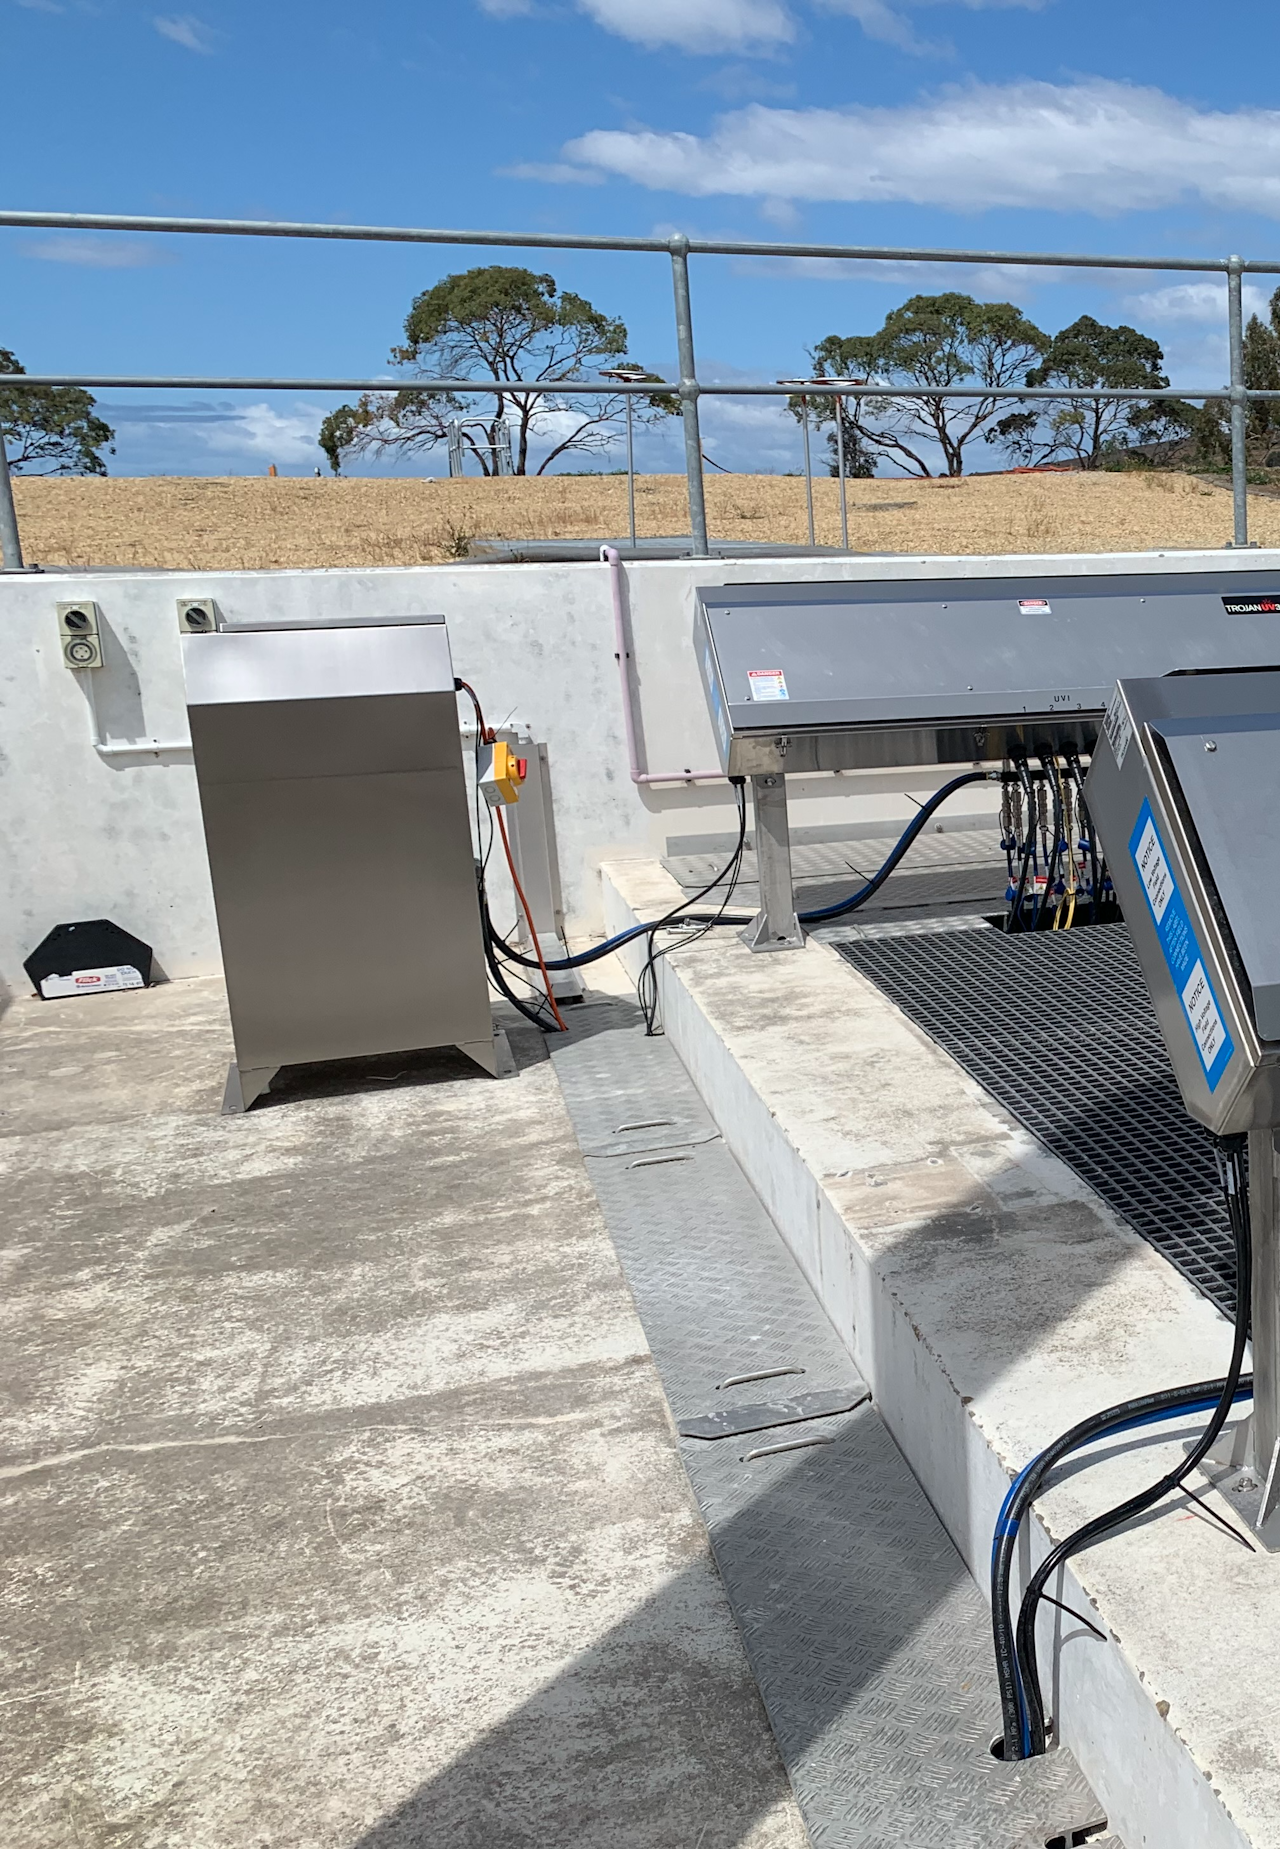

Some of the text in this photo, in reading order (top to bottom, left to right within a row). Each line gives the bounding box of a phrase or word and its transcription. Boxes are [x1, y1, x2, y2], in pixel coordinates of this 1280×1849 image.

[1049, 704, 1054, 712] 2
[1053, 695, 1070, 703] UVI
[1140, 834, 1156, 872] NOTICE
[1188, 976, 1205, 1013] NOTICE
[1201, 1019, 1218, 1052] Connections
[1207, 1038, 1216, 1055] ONLY
